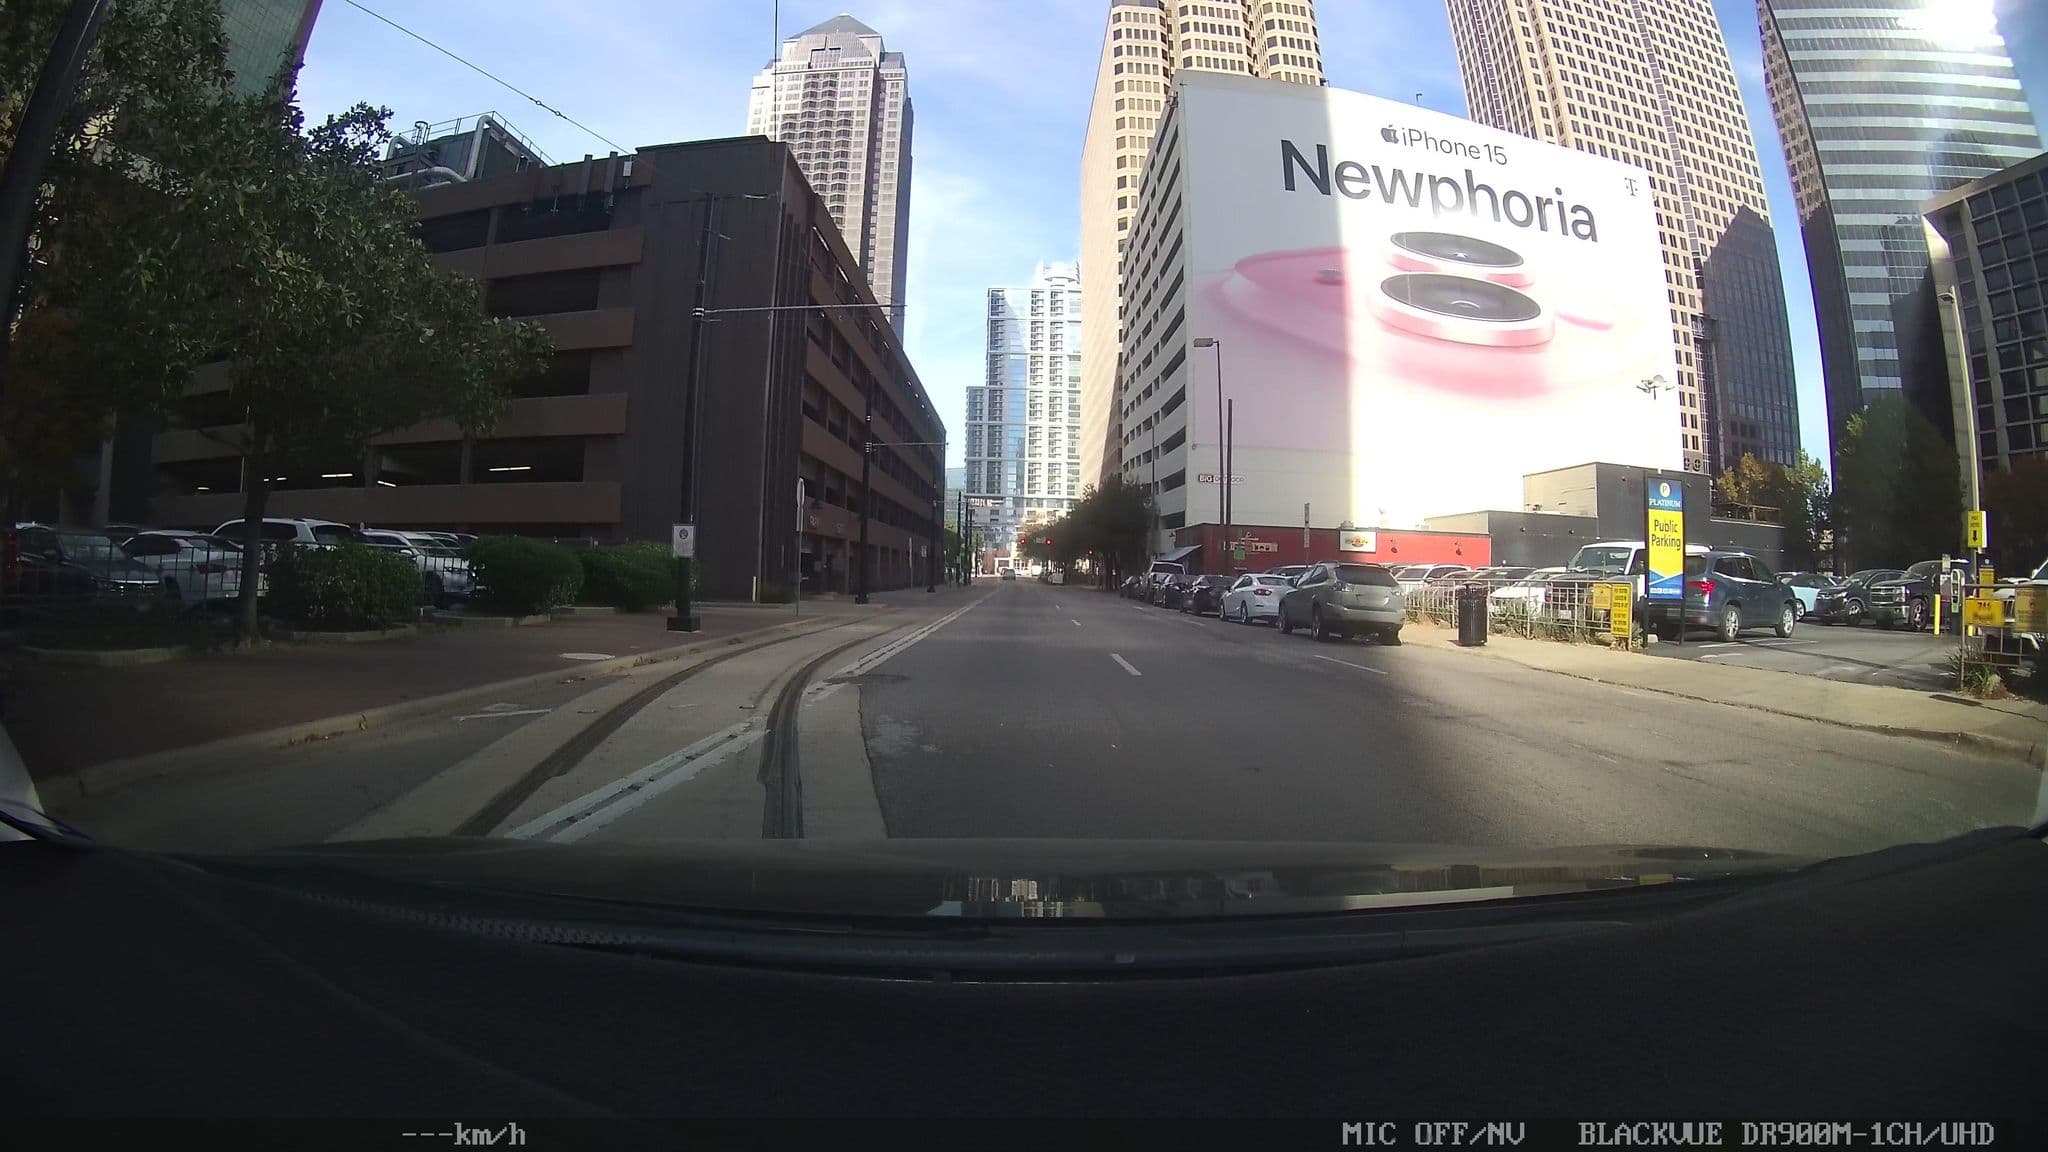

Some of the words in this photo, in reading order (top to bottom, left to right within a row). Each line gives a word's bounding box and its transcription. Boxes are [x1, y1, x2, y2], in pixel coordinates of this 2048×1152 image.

[1401, 126, 1481, 160] iPhone
[1484, 143, 1508, 165] 15
[1280, 138, 1598, 243] Newphoria
[1648, 498, 1681, 508] PLATINUM
[1654, 519, 1678, 533] Public
[1651, 534, 1681, 551] Parking
